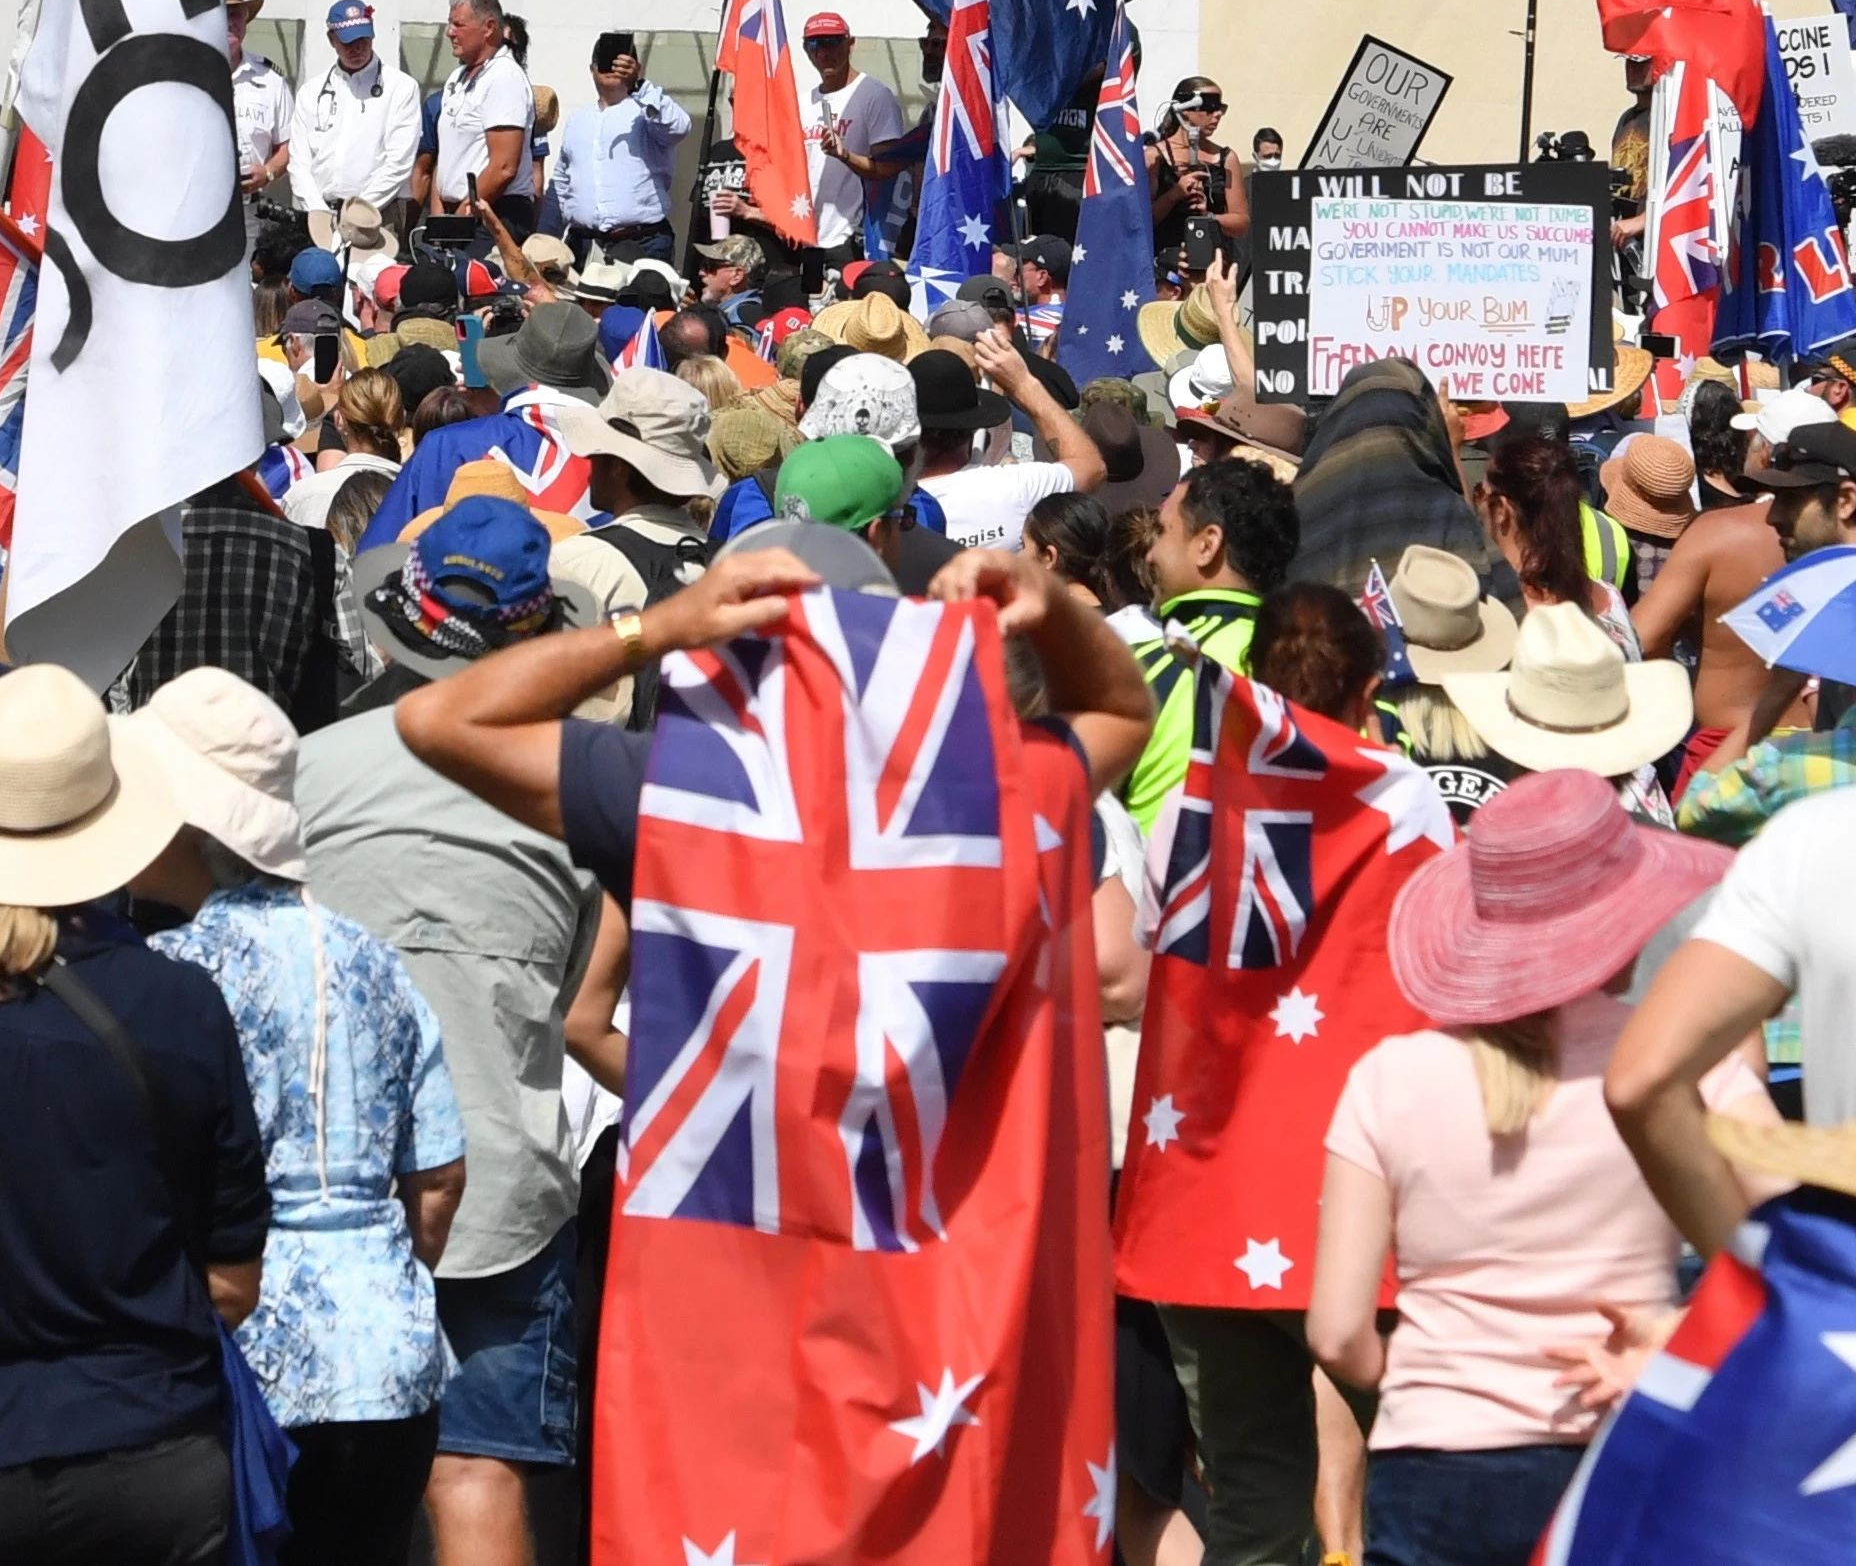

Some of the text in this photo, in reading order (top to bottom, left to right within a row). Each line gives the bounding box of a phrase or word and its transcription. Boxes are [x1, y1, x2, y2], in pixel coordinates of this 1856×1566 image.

[1365, 52, 1429, 105] OUR
[1357, 112, 1398, 142] ARE
[1291, 170, 1525, 200] I WILL NOT BE
[1369, 202, 1404, 219] NOT
[1515, 206, 1542, 223] NOT
[1549, 207, 1590, 224] DUMB
[1343, 221, 1594, 245] YOU CANNOT MAKE US SUCCUMB
[1317, 241, 1579, 266] GOVERNMENT IS NOT OUR MUM
[1320, 262, 1541, 286] STICK YOUR MANDATES
[1366, 293, 1529, 332] UP YOUR BUM
[1427, 342, 1505, 369] CONVOY
[1256, 368, 1295, 394] NO
[1452, 372, 1546, 396] WE COME
